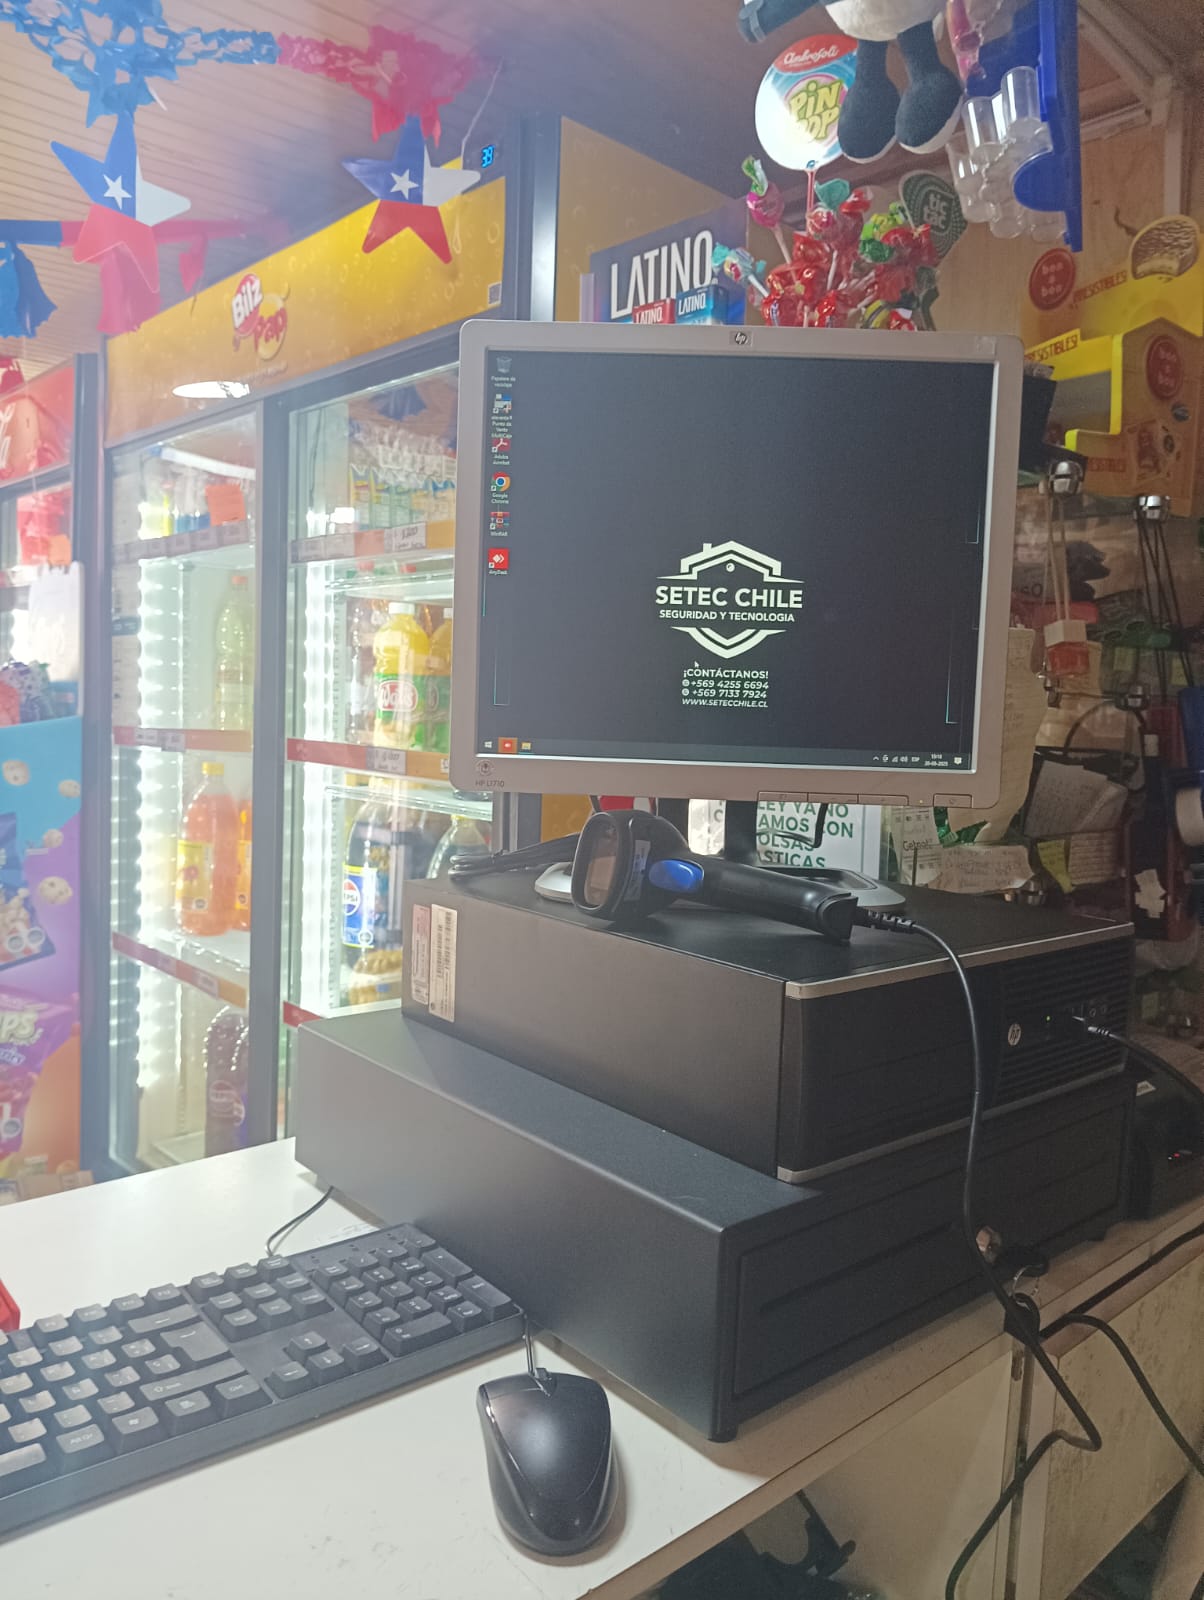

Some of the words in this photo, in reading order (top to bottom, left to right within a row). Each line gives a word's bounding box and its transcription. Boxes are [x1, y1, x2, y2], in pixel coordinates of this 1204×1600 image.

[610, 230, 714, 320] LATINO
[677, 292, 706, 316] LATINO
[655, 586, 728, 607] SETEC
[735, 588, 803, 609] CHILE
[659, 609, 717, 620] SEGURIDAD
[720, 611, 727, 620] Y
[729, 612, 795, 622] TECNOLOGIA
[691, 680, 715, 688] +569
[717, 680, 741, 689] 4255
[743, 681, 769, 690] 6694
[692, 689, 716, 697] +569
[718, 689, 740, 697] 7133
[743, 690, 767, 698] 7924
[758, 814, 809, 832] AMOS
[823, 821, 853, 838] ON
[758, 833, 814, 851] OLSAS
[758, 850, 826, 868] STICAS
